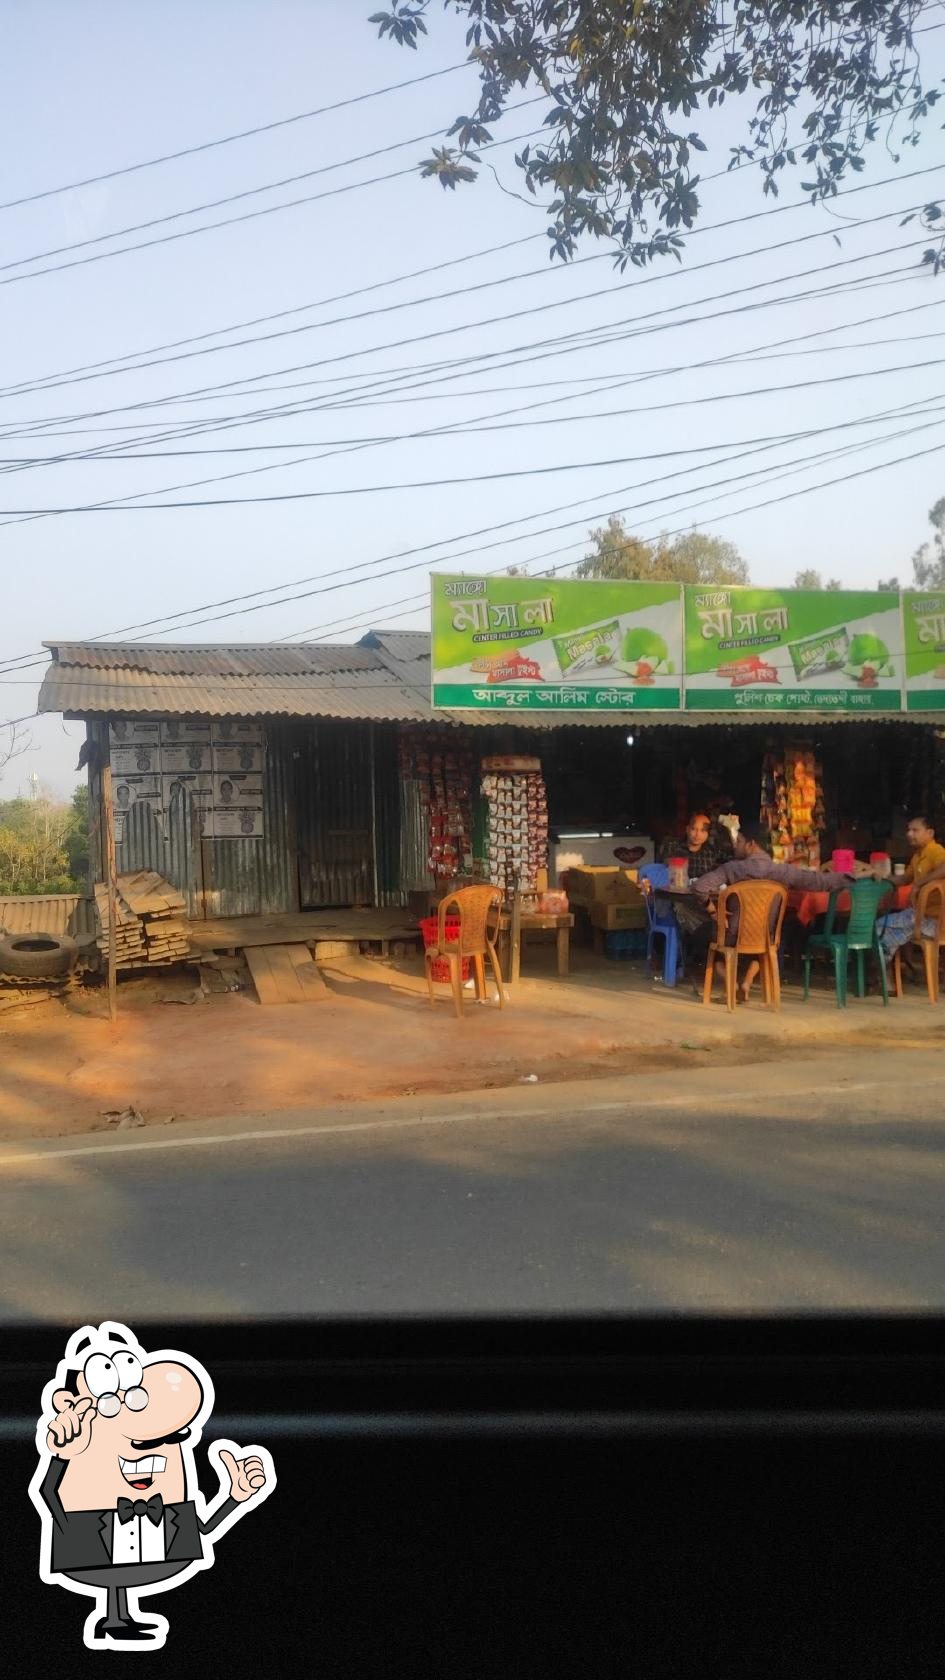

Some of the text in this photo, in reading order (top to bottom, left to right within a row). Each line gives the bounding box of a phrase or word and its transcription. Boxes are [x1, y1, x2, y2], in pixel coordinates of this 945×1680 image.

[449, 597, 554, 632] মাসালা
[697, 607, 789, 640] মাসালা
[520, 628, 543, 638] CANDY
[472, 686, 636, 706] আব্দুল আলিম স্টোর
